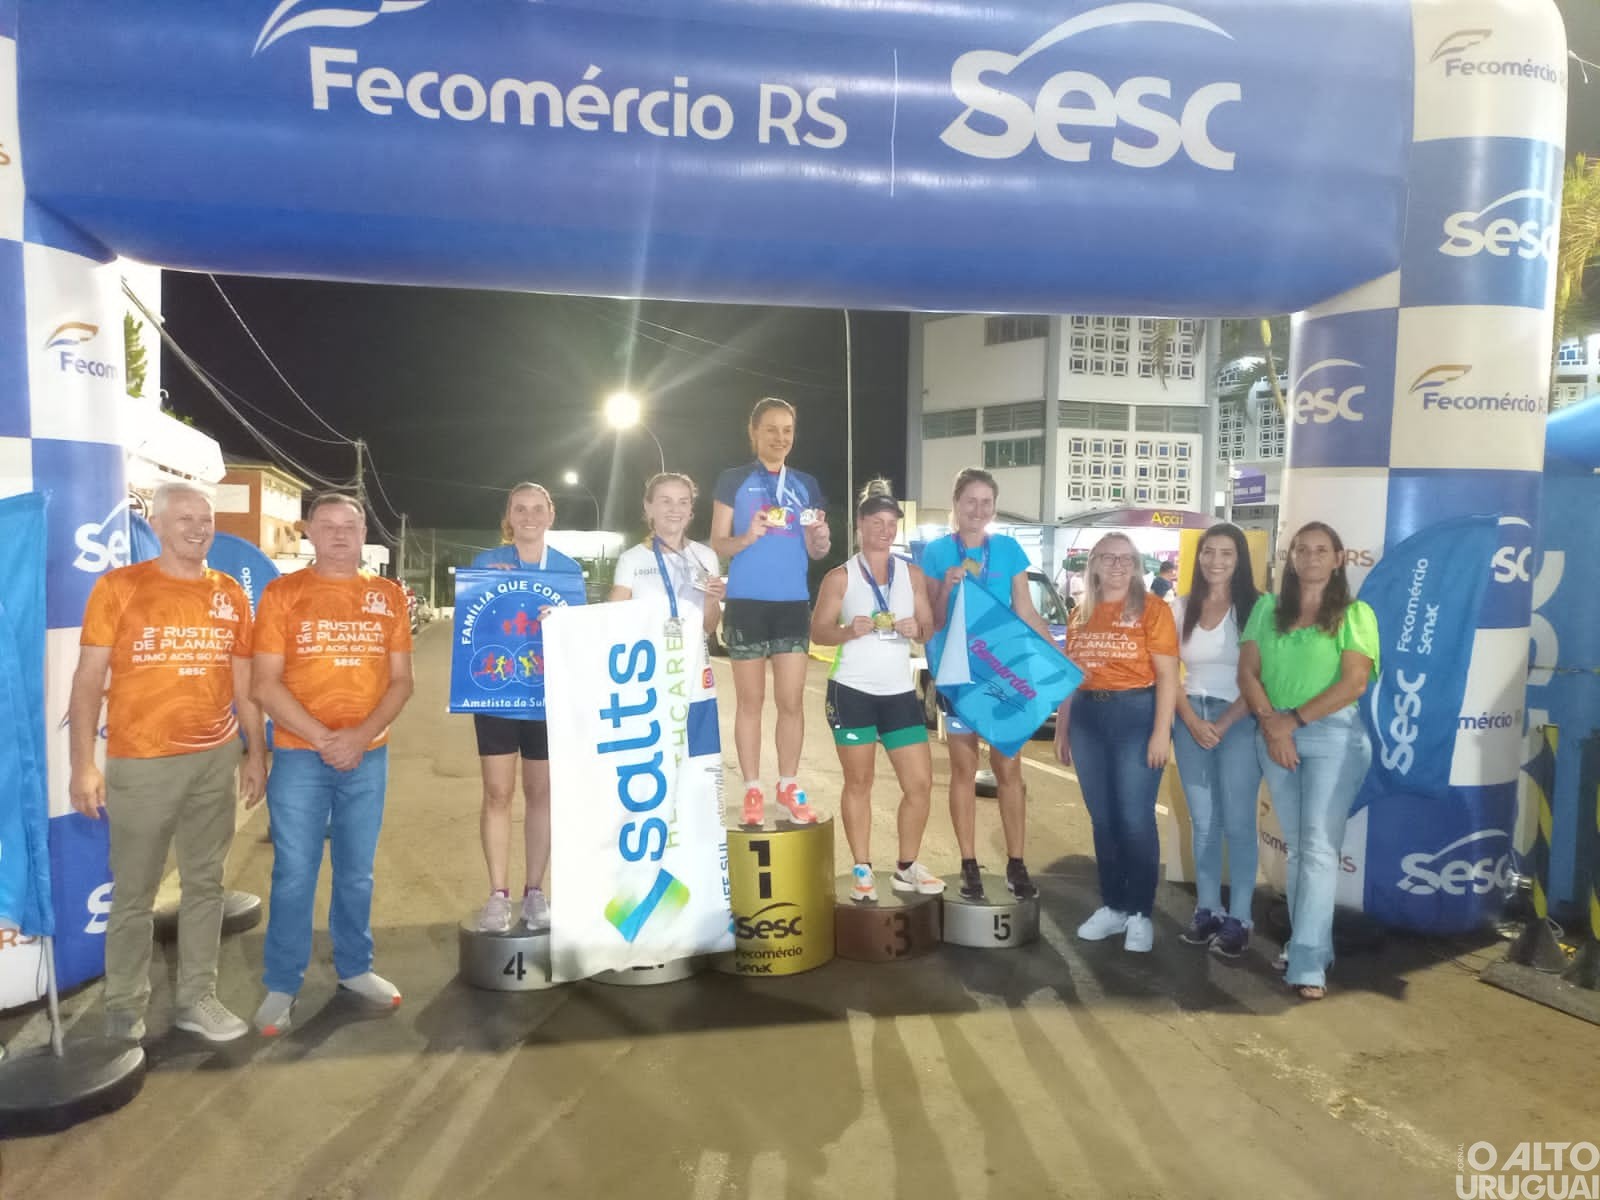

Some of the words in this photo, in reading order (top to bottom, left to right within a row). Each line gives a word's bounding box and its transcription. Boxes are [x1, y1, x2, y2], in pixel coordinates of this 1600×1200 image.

[1445, 58, 1557, 84] Fecomércio
[309, 46, 735, 141] Fecomércio
[758, 83, 848, 149] RS
[938, 49, 1242, 171] Sesc
[1423, 391, 1536, 413] Fecomércio
[497, 581, 529, 594] QUE
[1396, 558, 1429, 652] Fecomércio
[296, 633, 312, 644] DE
[1417, 603, 1440, 655] Senac
[133, 639, 155, 652] DE
[1380, 669, 1426, 776] Sesc
[596, 639, 668, 862] salts
[749, 840, 772, 899] 1
[735, 915, 803, 939] Sesc
[993, 913, 1011, 941] 5
[503, 952, 527, 980] 4
